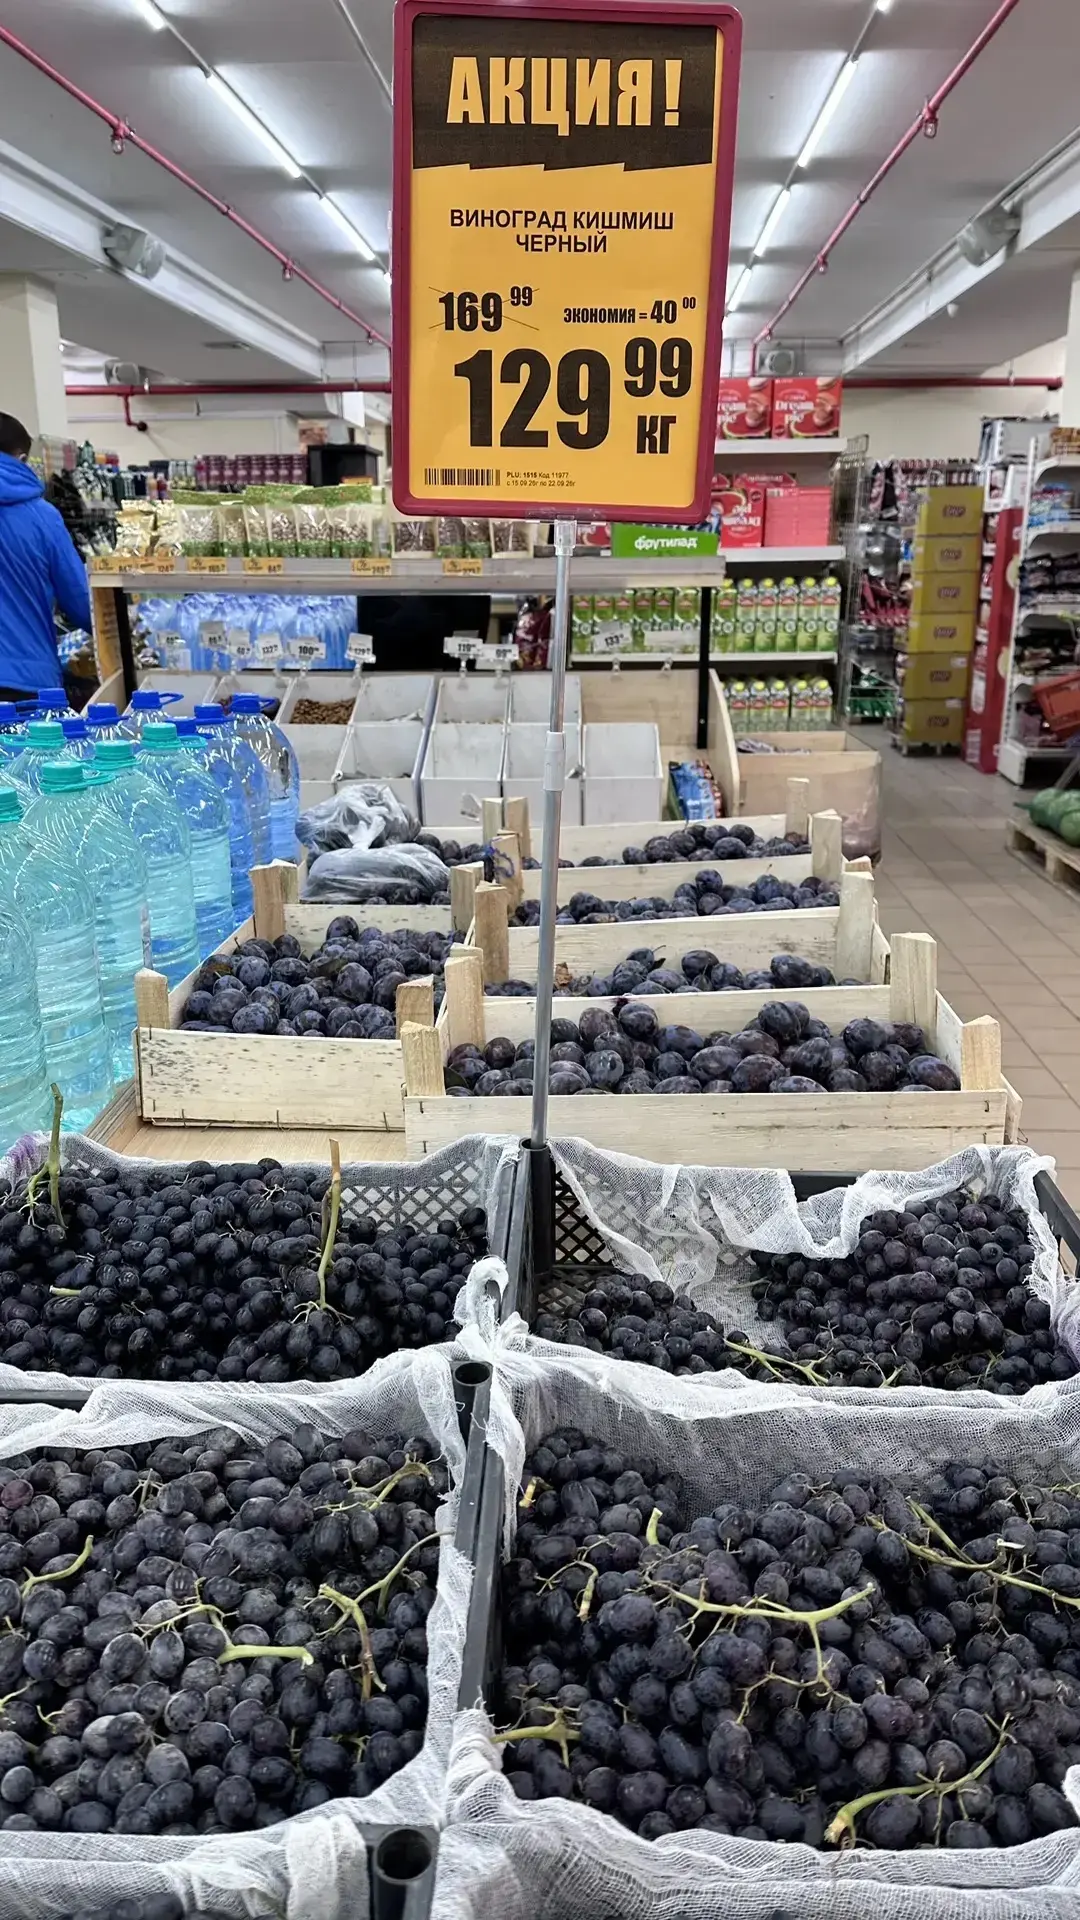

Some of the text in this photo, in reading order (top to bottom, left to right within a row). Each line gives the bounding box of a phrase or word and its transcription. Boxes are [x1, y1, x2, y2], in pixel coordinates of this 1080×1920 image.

[446, 56, 683, 137] АКЦИЯ!
[450, 209, 674, 232] ВИНОГРАД КИШМИШ
[516, 230, 608, 253] ЧЕРНЫЙ
[438, 286, 533, 332] 169 99
[454, 337, 693, 450] 129 99
[634, 535, 699, 551] фрутилад
